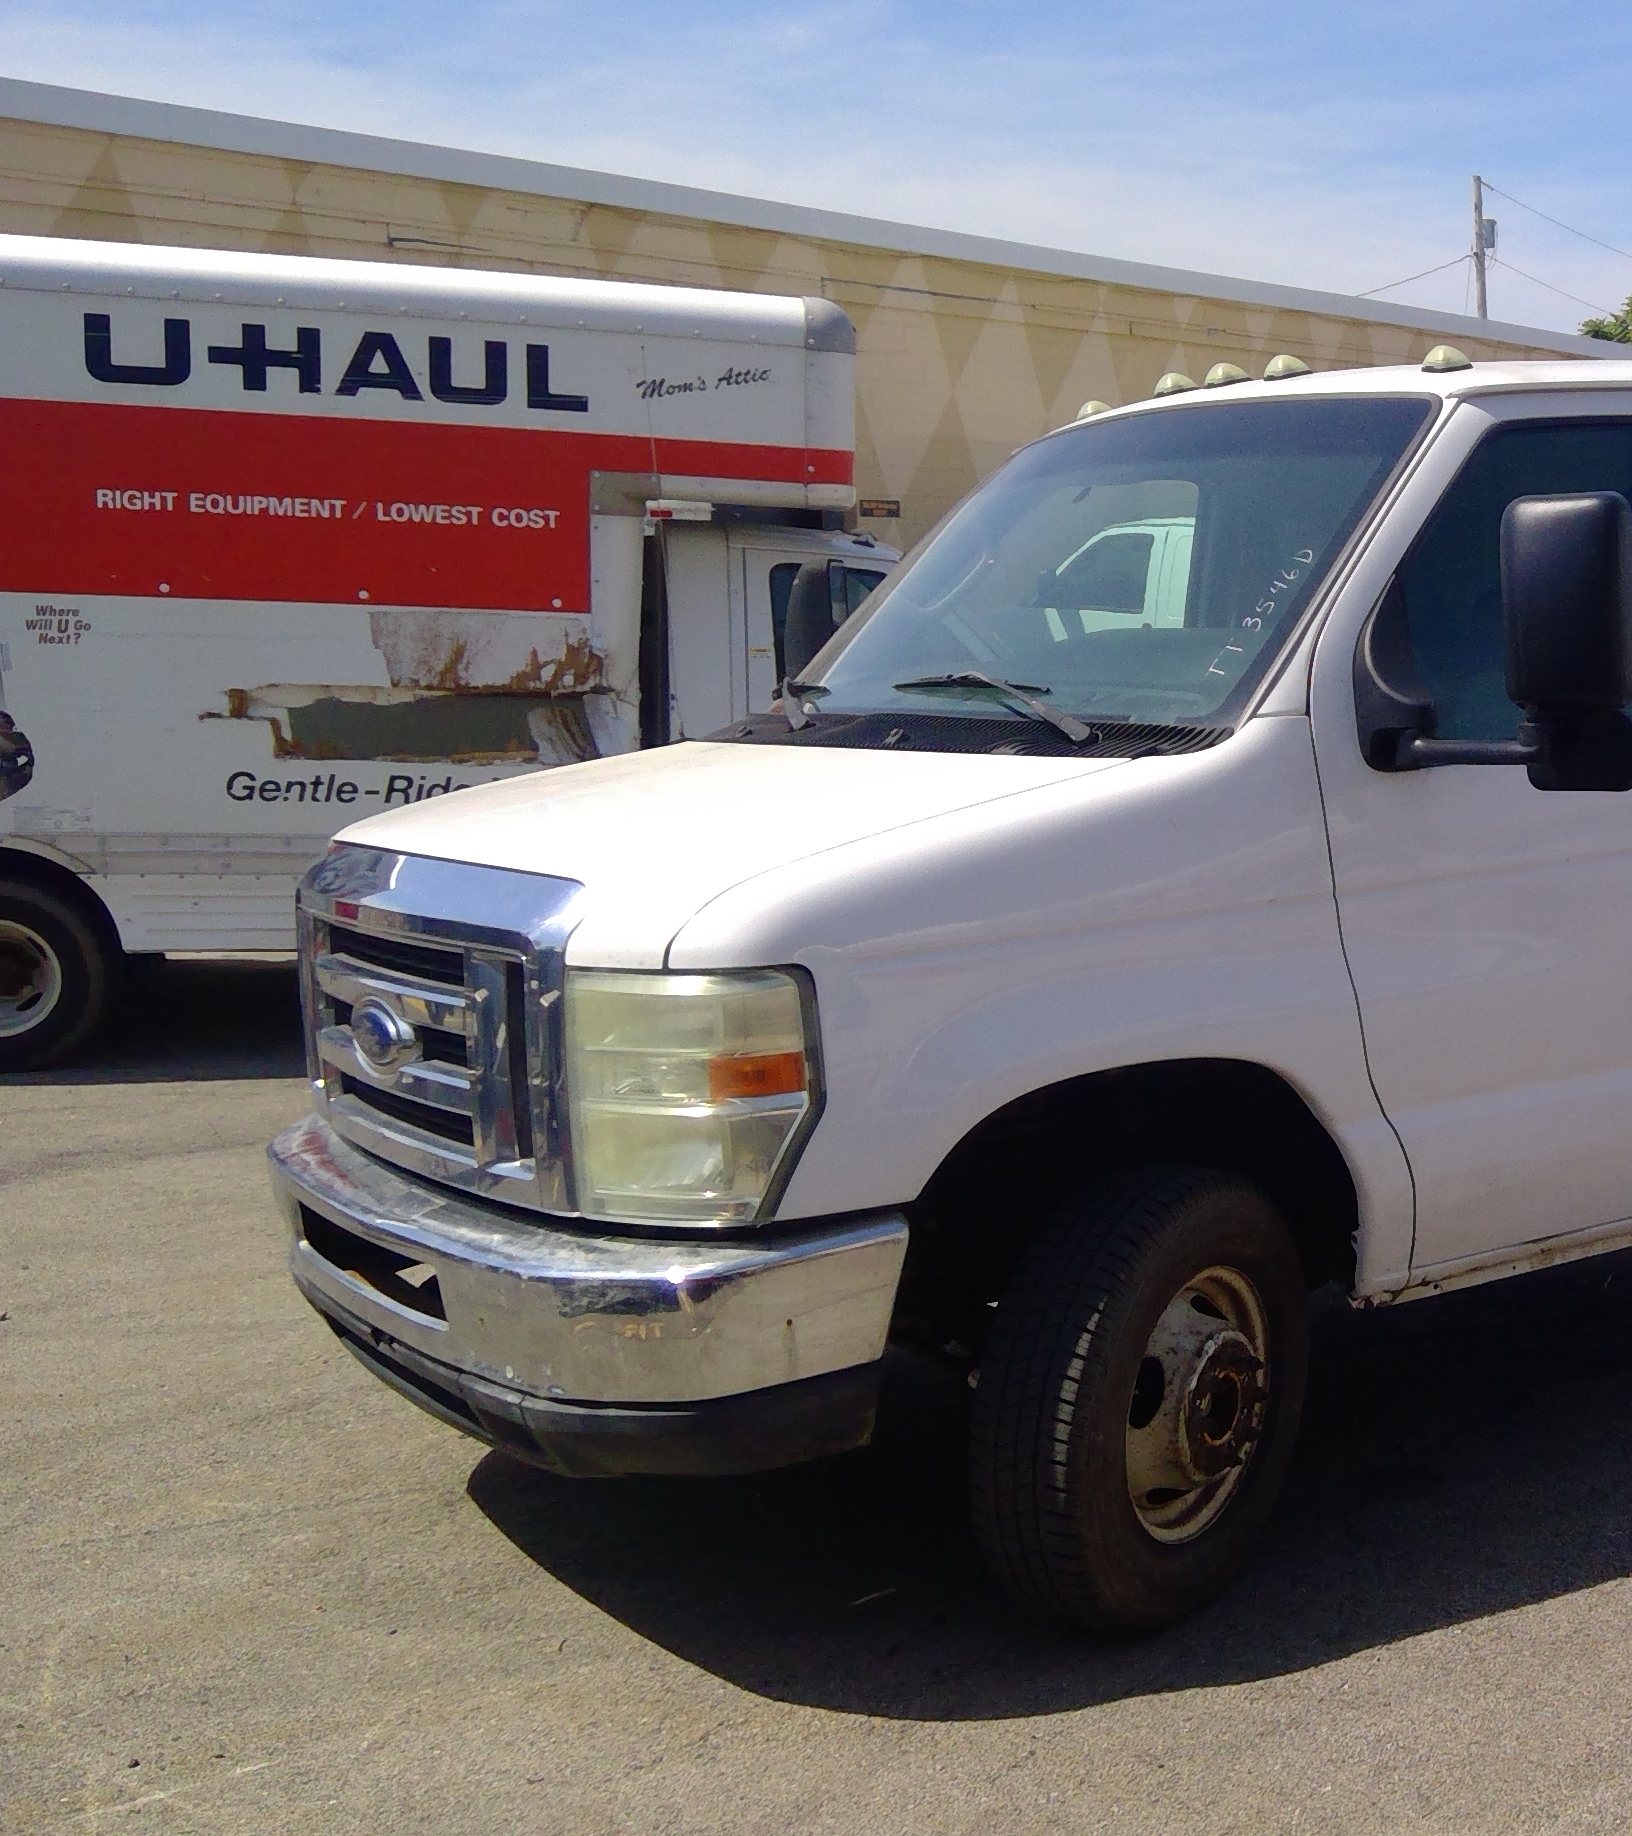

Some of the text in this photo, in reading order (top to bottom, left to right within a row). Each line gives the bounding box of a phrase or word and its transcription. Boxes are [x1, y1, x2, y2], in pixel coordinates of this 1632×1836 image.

[84, 312, 588, 413] U-HAUL
[636, 367, 772, 400] Mom's Attic
[96, 489, 178, 511] RIGHT
[189, 492, 347, 519] EQUIPMENT
[375, 501, 484, 525] LOWEST
[490, 507, 561, 529] COST
[36, 605, 80, 617] Where
[25, 619, 92, 634] Will U Go
[39, 633, 82, 644] Next?
